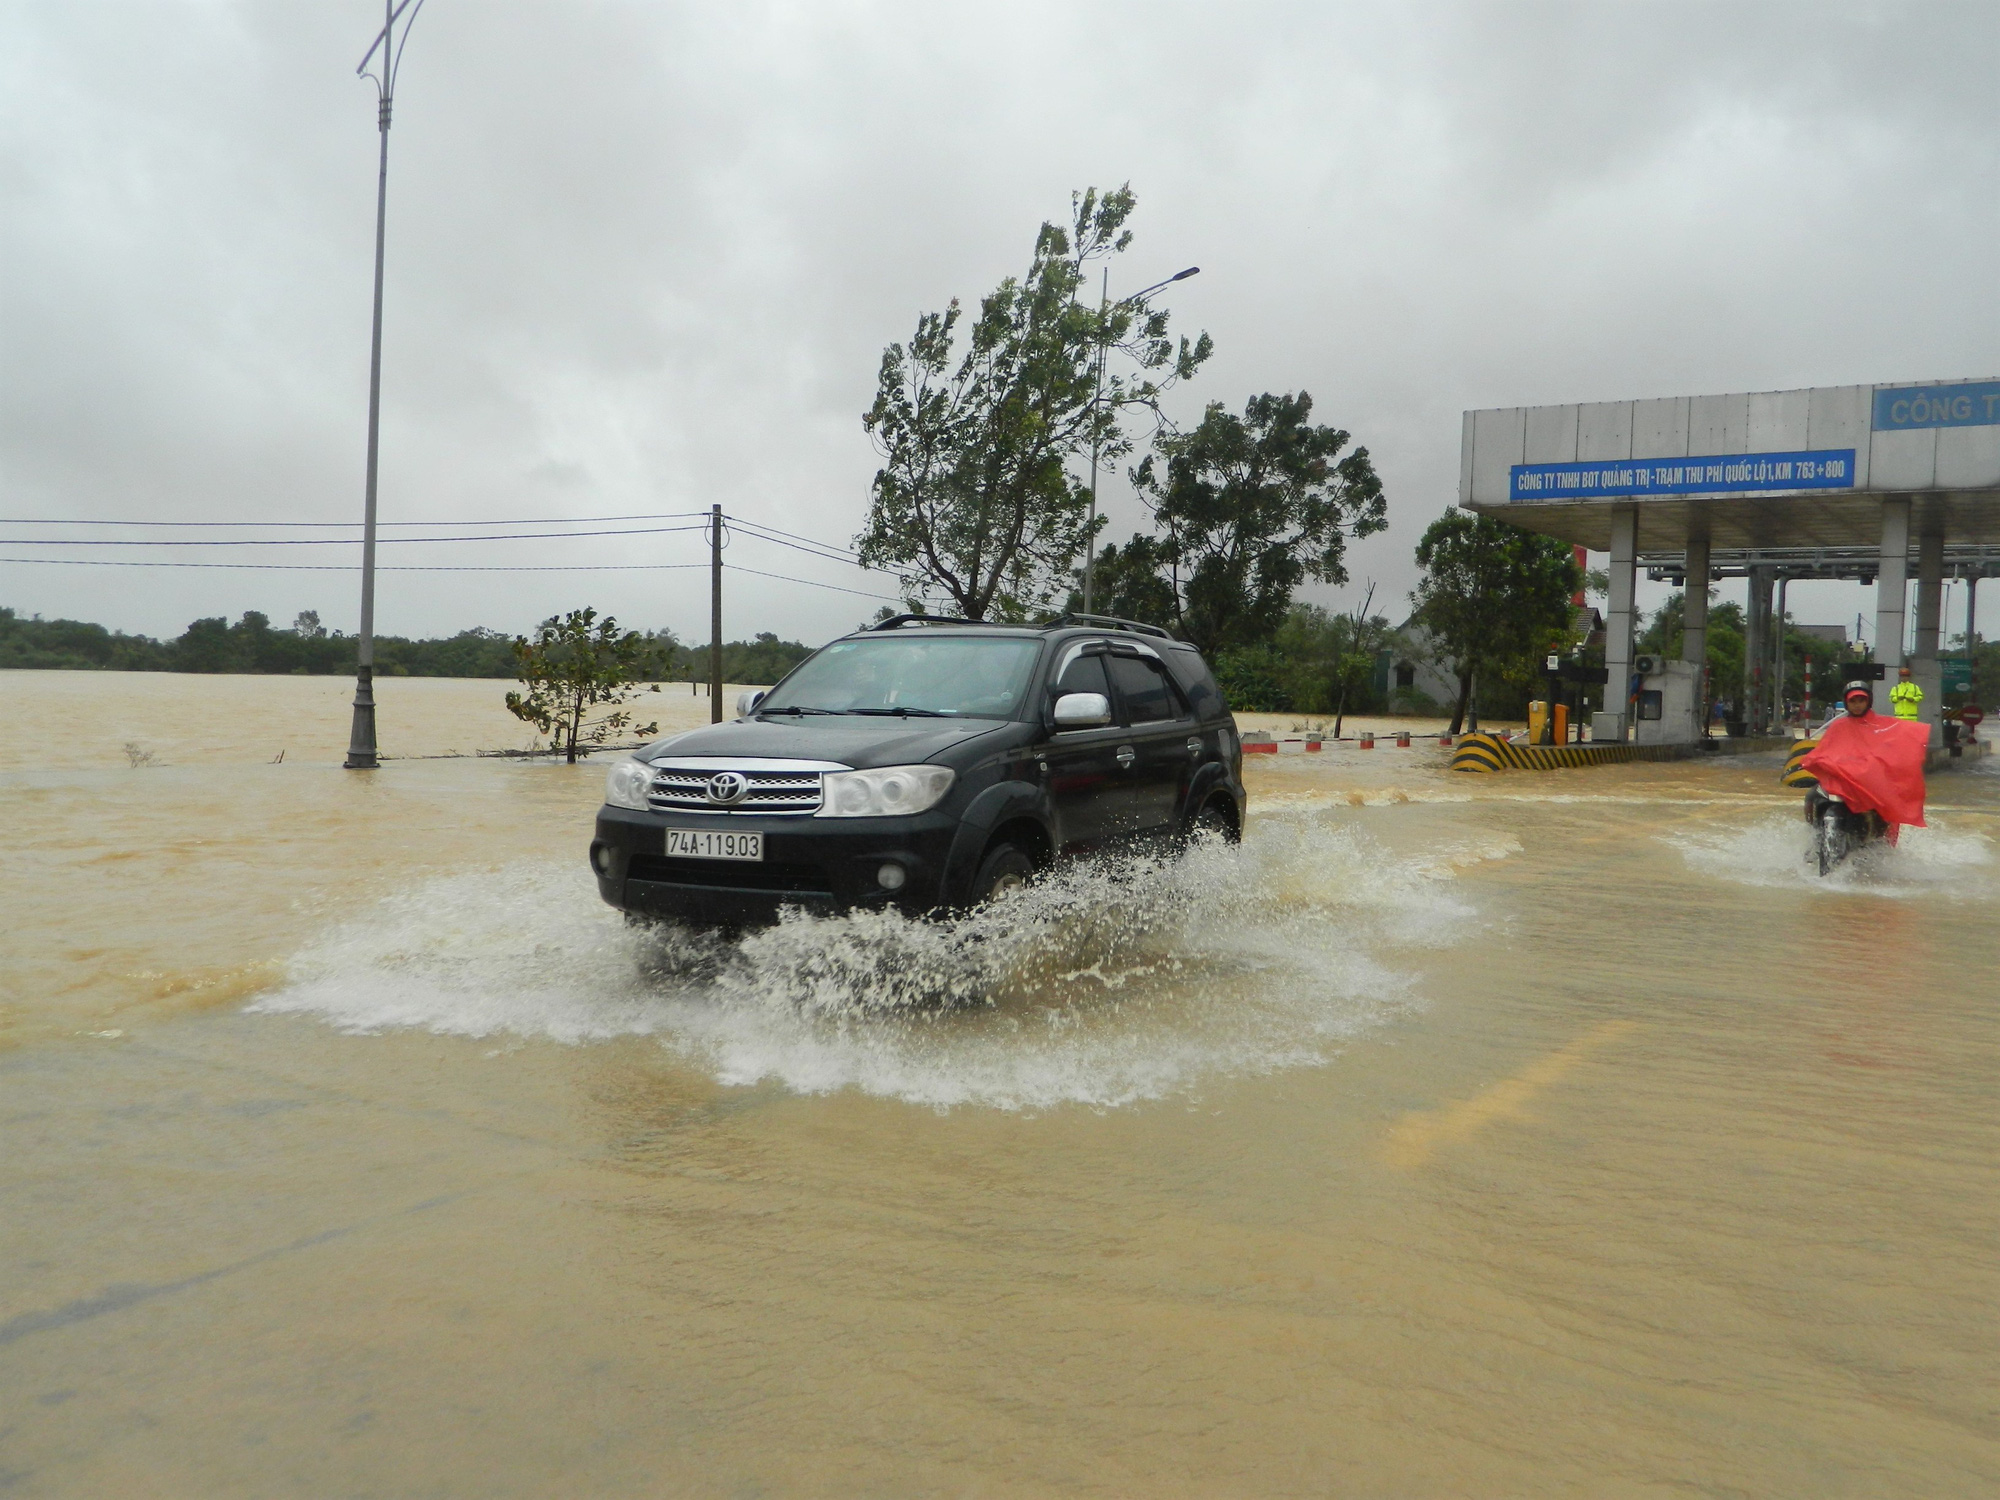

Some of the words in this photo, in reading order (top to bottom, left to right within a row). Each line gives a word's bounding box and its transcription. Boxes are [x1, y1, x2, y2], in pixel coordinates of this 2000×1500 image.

[1891, 392, 1972, 424] CÔNG
[1518, 471, 1542, 491] CÔNG
[1544, 472, 1555, 489] TY
[1556, 472, 1580, 489] TNHH
[1582, 471, 1599, 488] BOT
[1601, 464, 1632, 489] QUẢNG
[1685, 466, 1703, 484] THU
[1706, 462, 1723, 482] PHÍ
[1725, 459, 1752, 484] QUỐC
[670, 832, 759, 857] 74A-119.03
